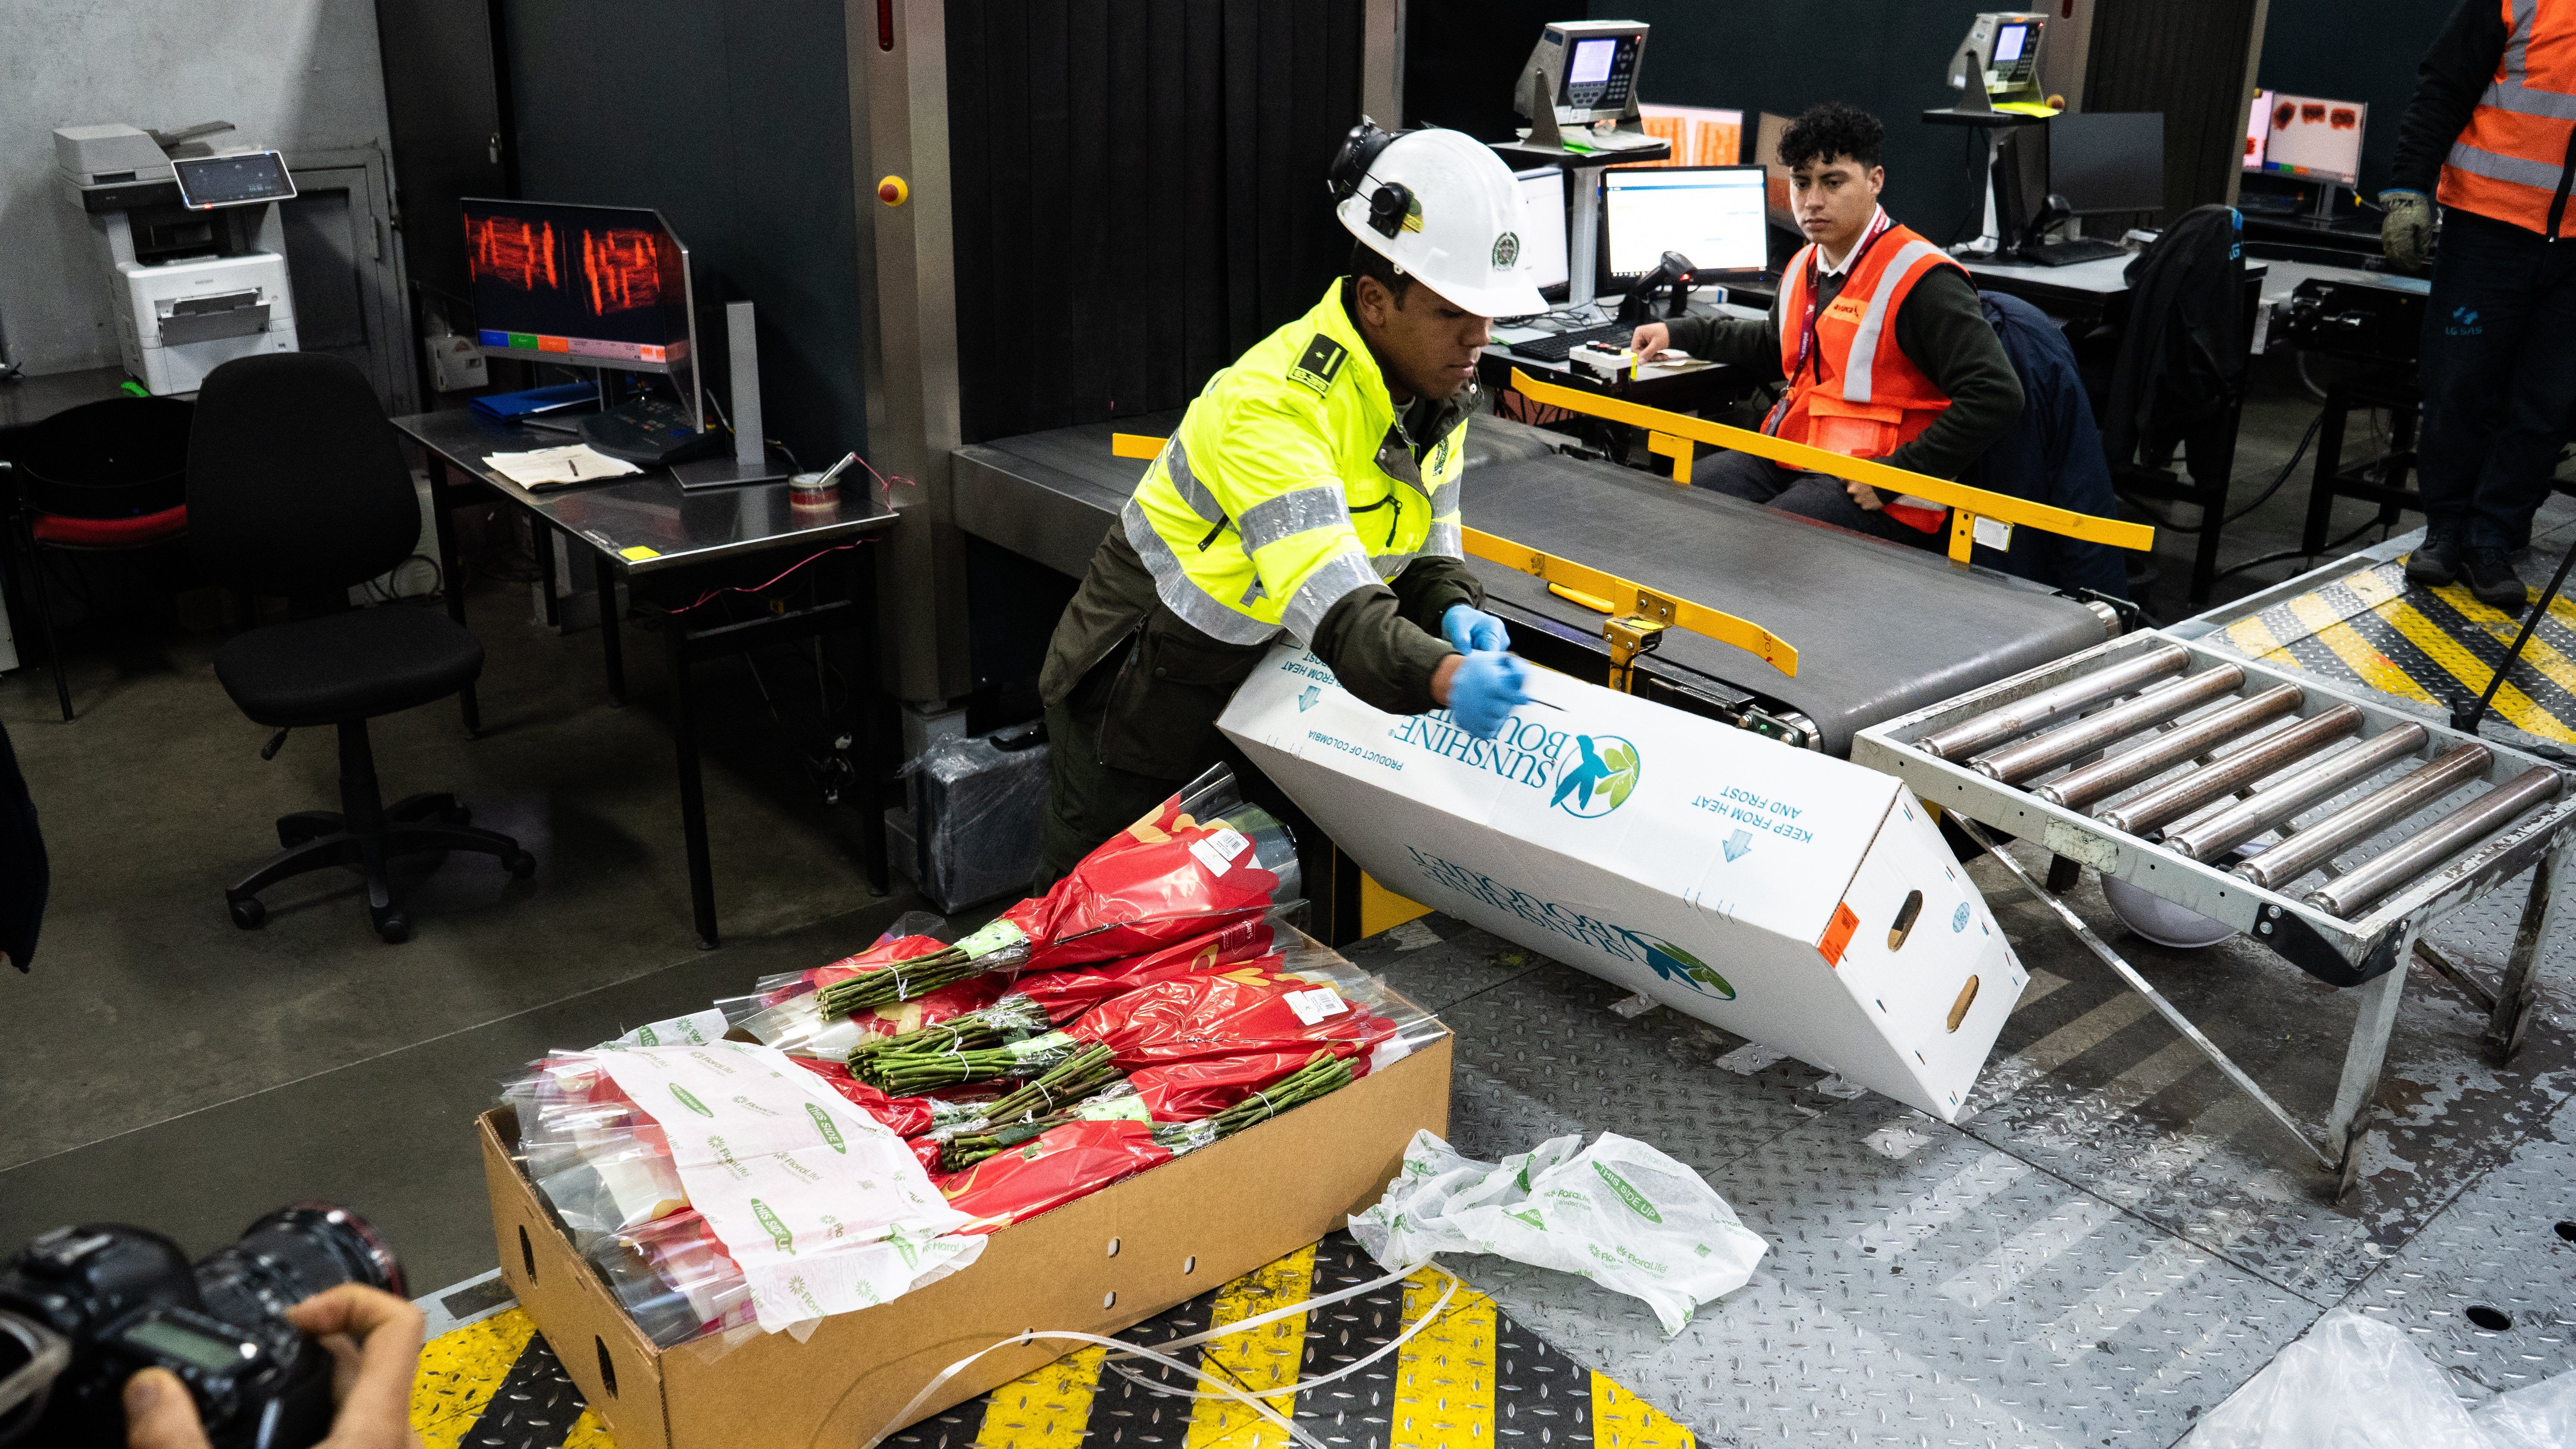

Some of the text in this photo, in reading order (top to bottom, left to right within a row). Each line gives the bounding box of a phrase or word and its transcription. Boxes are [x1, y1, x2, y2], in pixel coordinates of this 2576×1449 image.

[1281, 661, 1308, 676] HEAT
[1302, 652, 1330, 668] OST
[1308, 668, 1337, 685] FROM
[1308, 730, 1404, 771] PRODUCT OF COLOMBIA
[1394, 714, 1555, 788] SUNSHINE
[1719, 785, 1803, 819] AND FROST
[1691, 795, 1813, 844] KEEP FROM HEAT
[821, 1122, 839, 1143] SIDE
[785, 1158, 820, 1180] FloraLife
[1599, 1165, 1619, 1186] THIS
[1620, 1185, 1641, 1207] SIDE
[1640, 1203, 1656, 1218] UP
[1628, 1252, 1667, 1273] FloraLife
